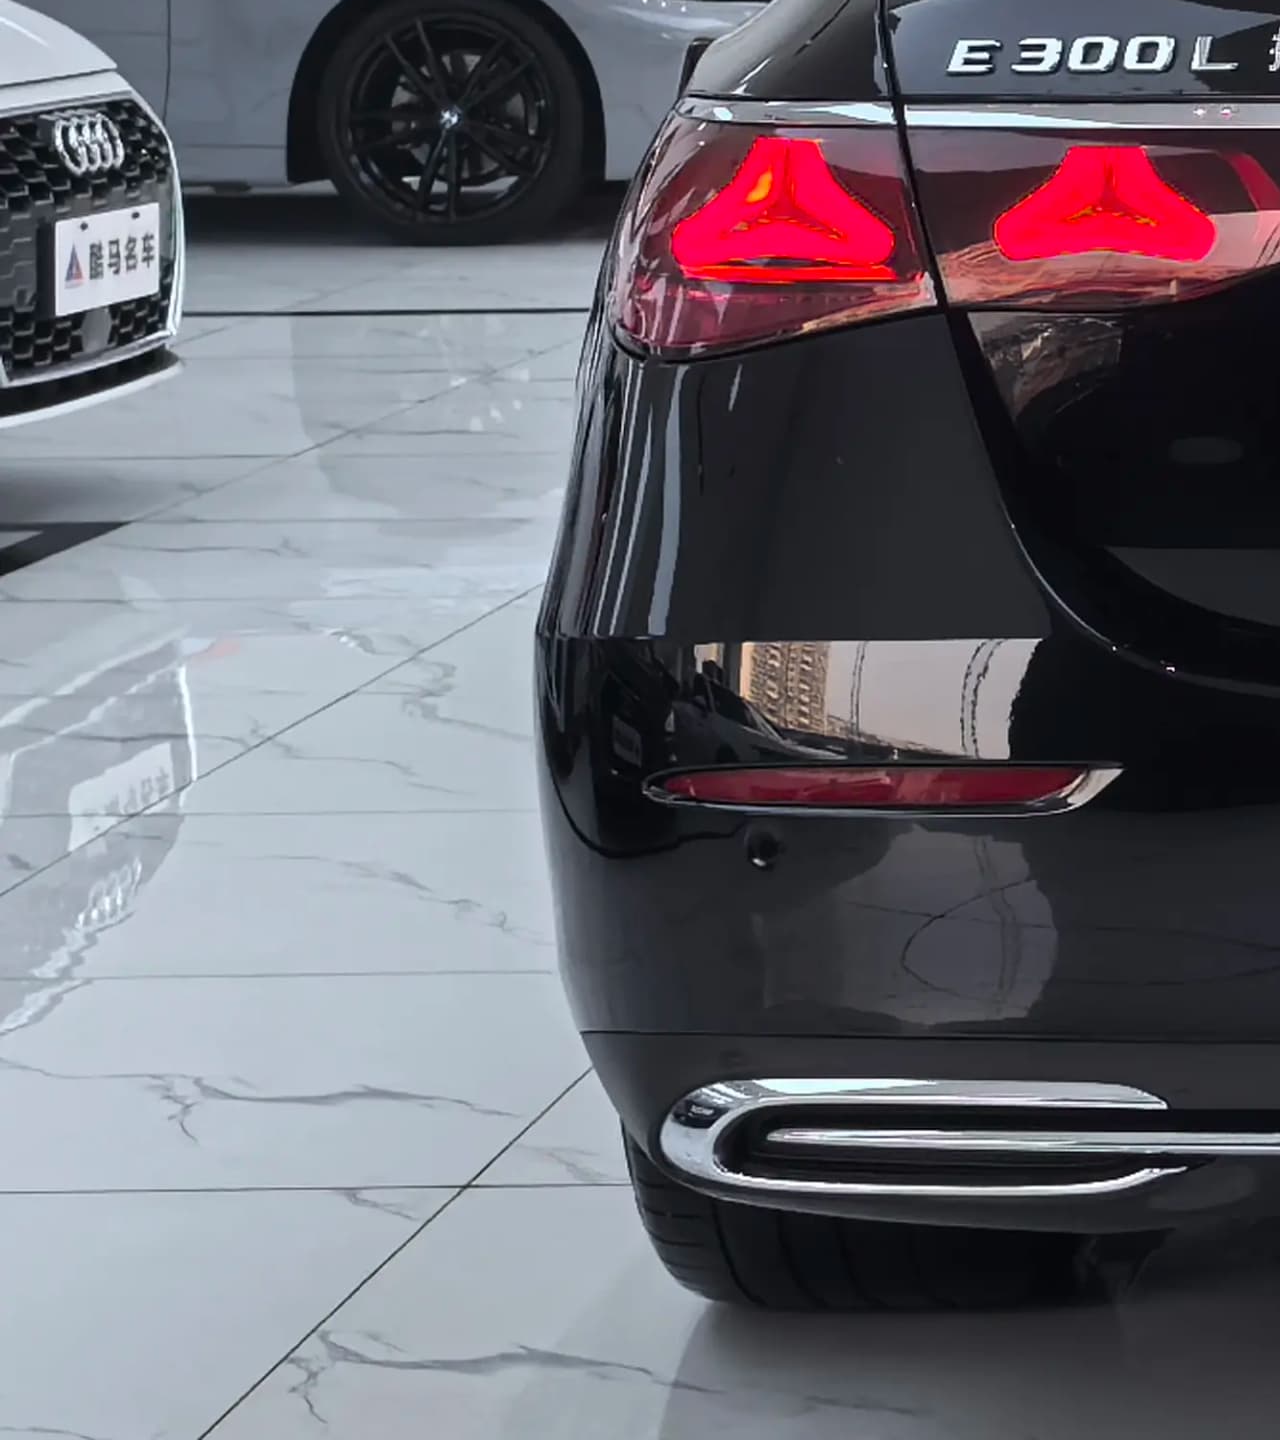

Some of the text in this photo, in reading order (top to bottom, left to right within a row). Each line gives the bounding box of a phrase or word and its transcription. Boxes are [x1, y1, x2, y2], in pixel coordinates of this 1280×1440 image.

[948, 35, 1239, 74] E 300 L
